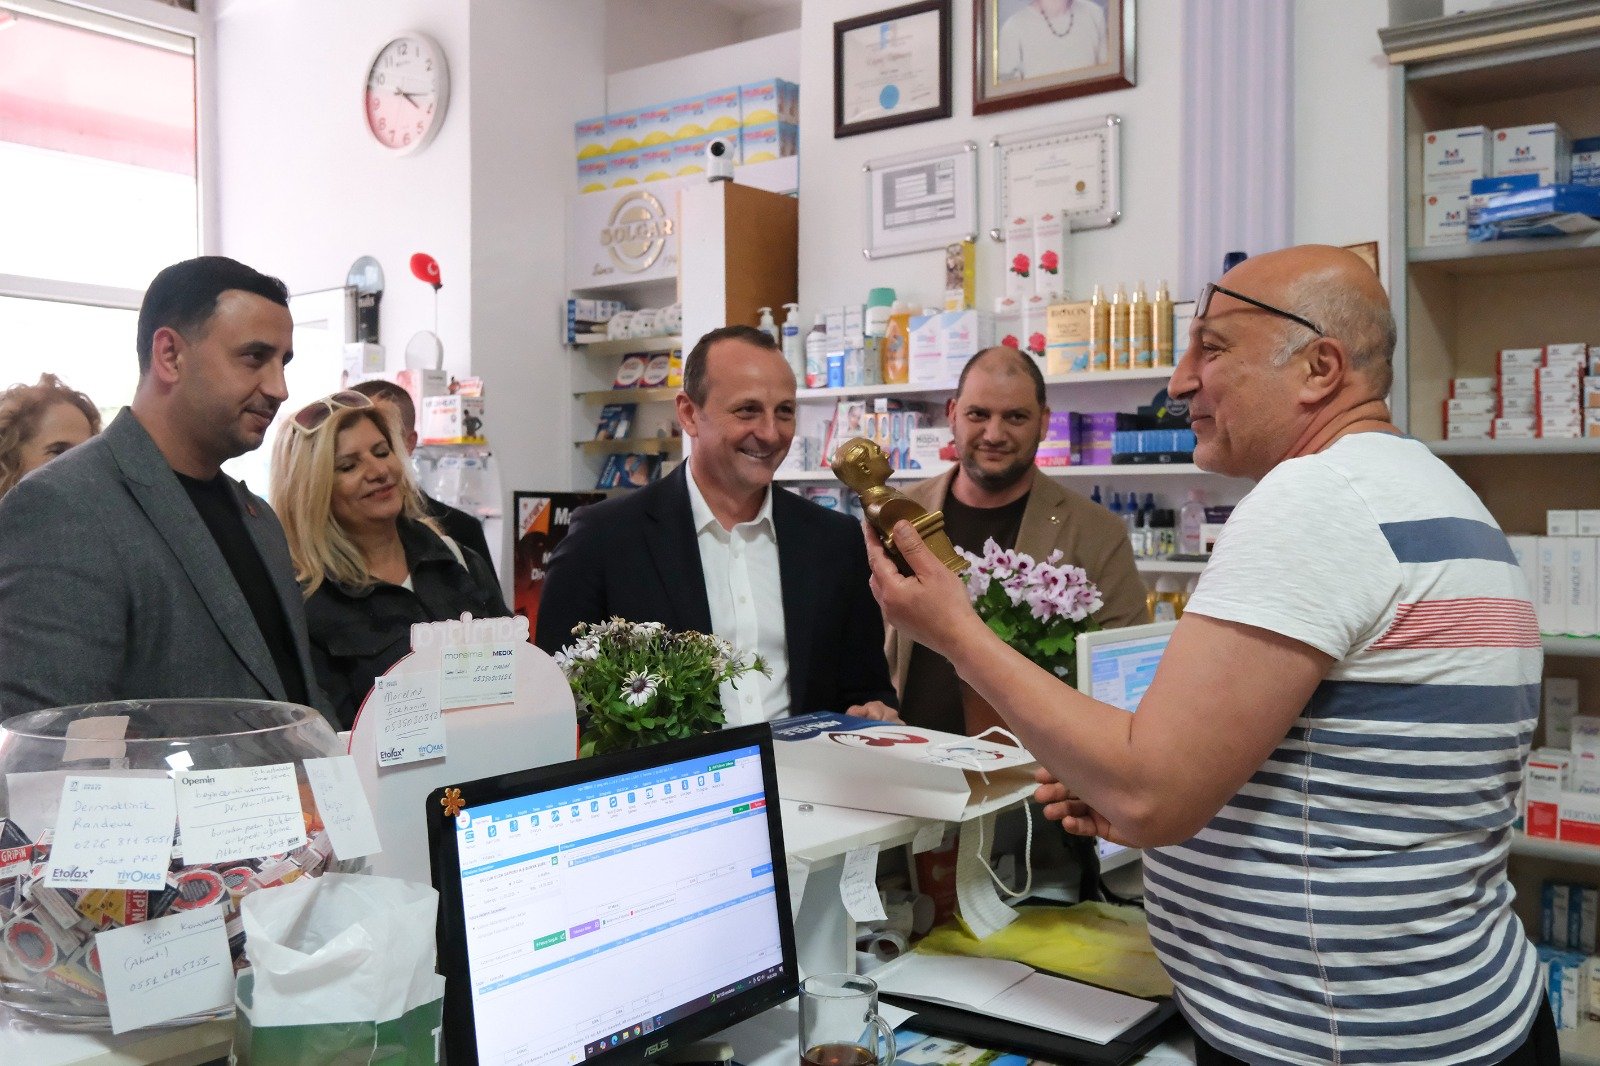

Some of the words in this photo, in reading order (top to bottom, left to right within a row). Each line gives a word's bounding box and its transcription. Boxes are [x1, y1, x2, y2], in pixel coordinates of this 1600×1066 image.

[398, 42, 408, 56] 12
[425, 58, 432, 72] 2
[403, 132, 412, 146] 6
[601, 217, 674, 246] SOLGAR
[492, 649, 513, 657] MEDIX
[182, 776, 216, 787] Opemin
[643, 1037, 671, 1058] ASUS
